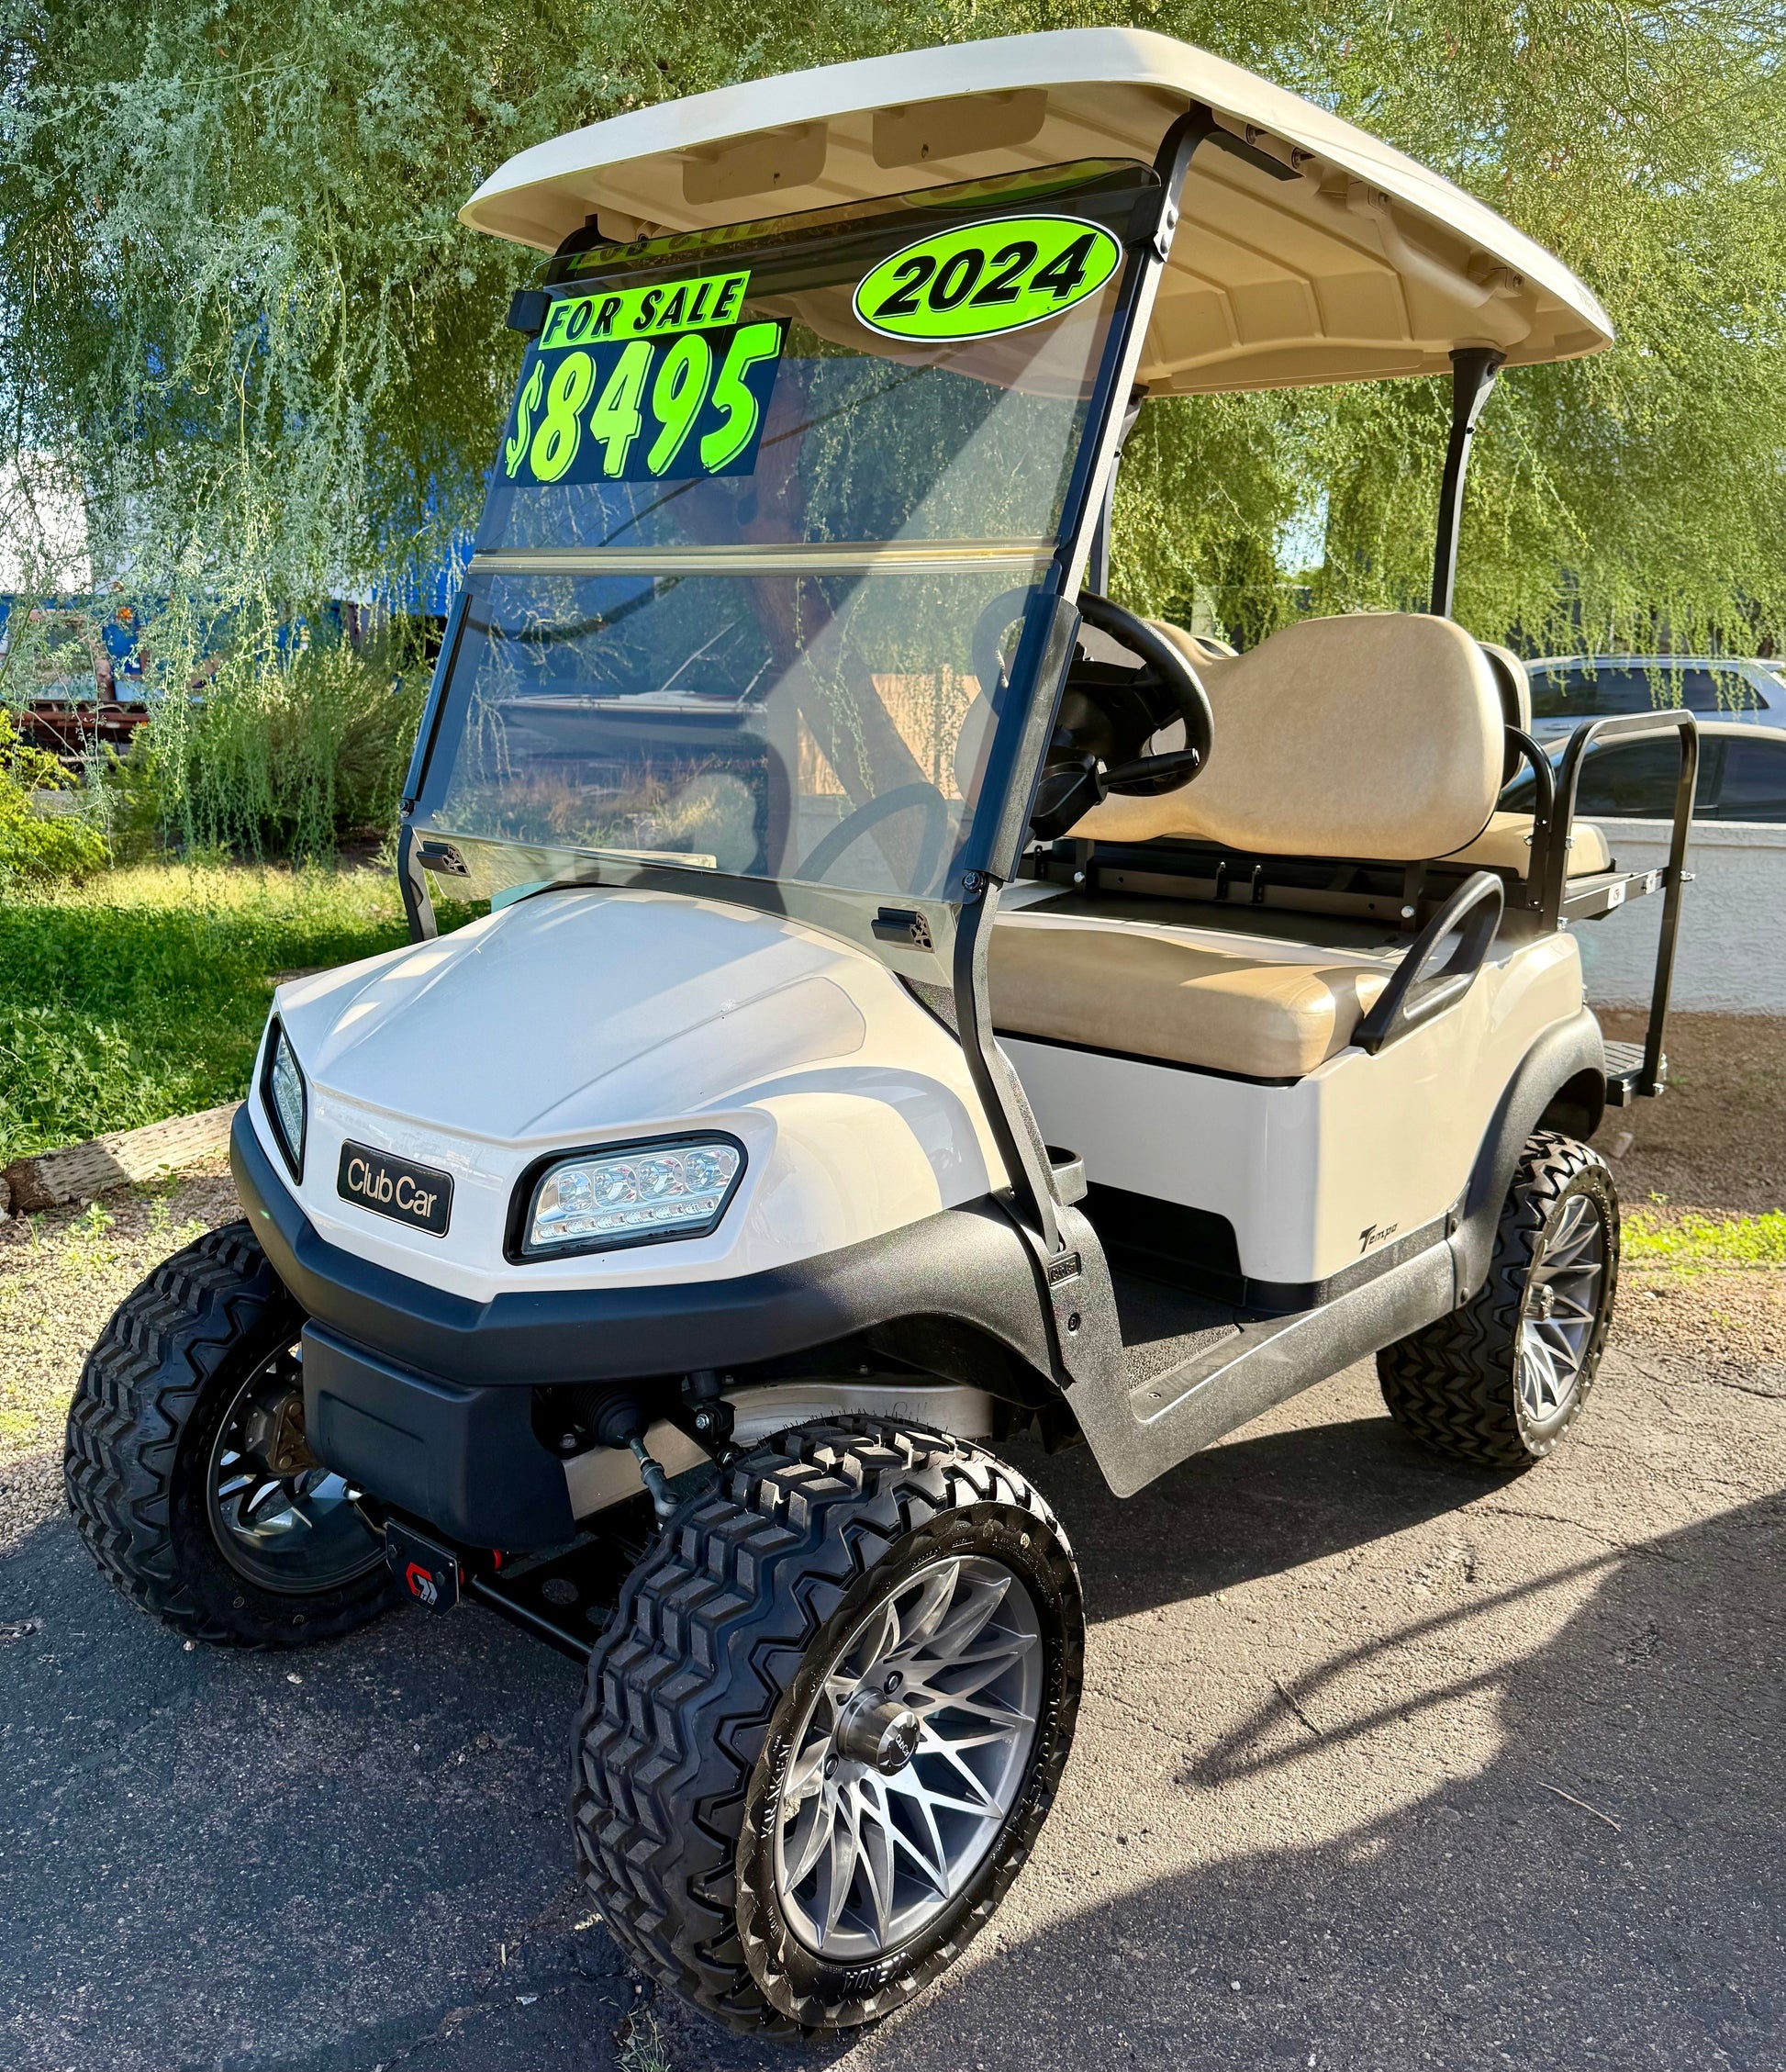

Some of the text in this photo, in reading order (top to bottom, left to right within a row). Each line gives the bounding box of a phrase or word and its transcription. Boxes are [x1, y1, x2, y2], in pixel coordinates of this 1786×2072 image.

[542, 276, 744, 345] FOR SALE
[872, 232, 1099, 320] 2024
[505, 321, 782, 482] $8495
[347, 1158, 438, 1218] Club Car
[1357, 1223, 1399, 1255] Tempo
